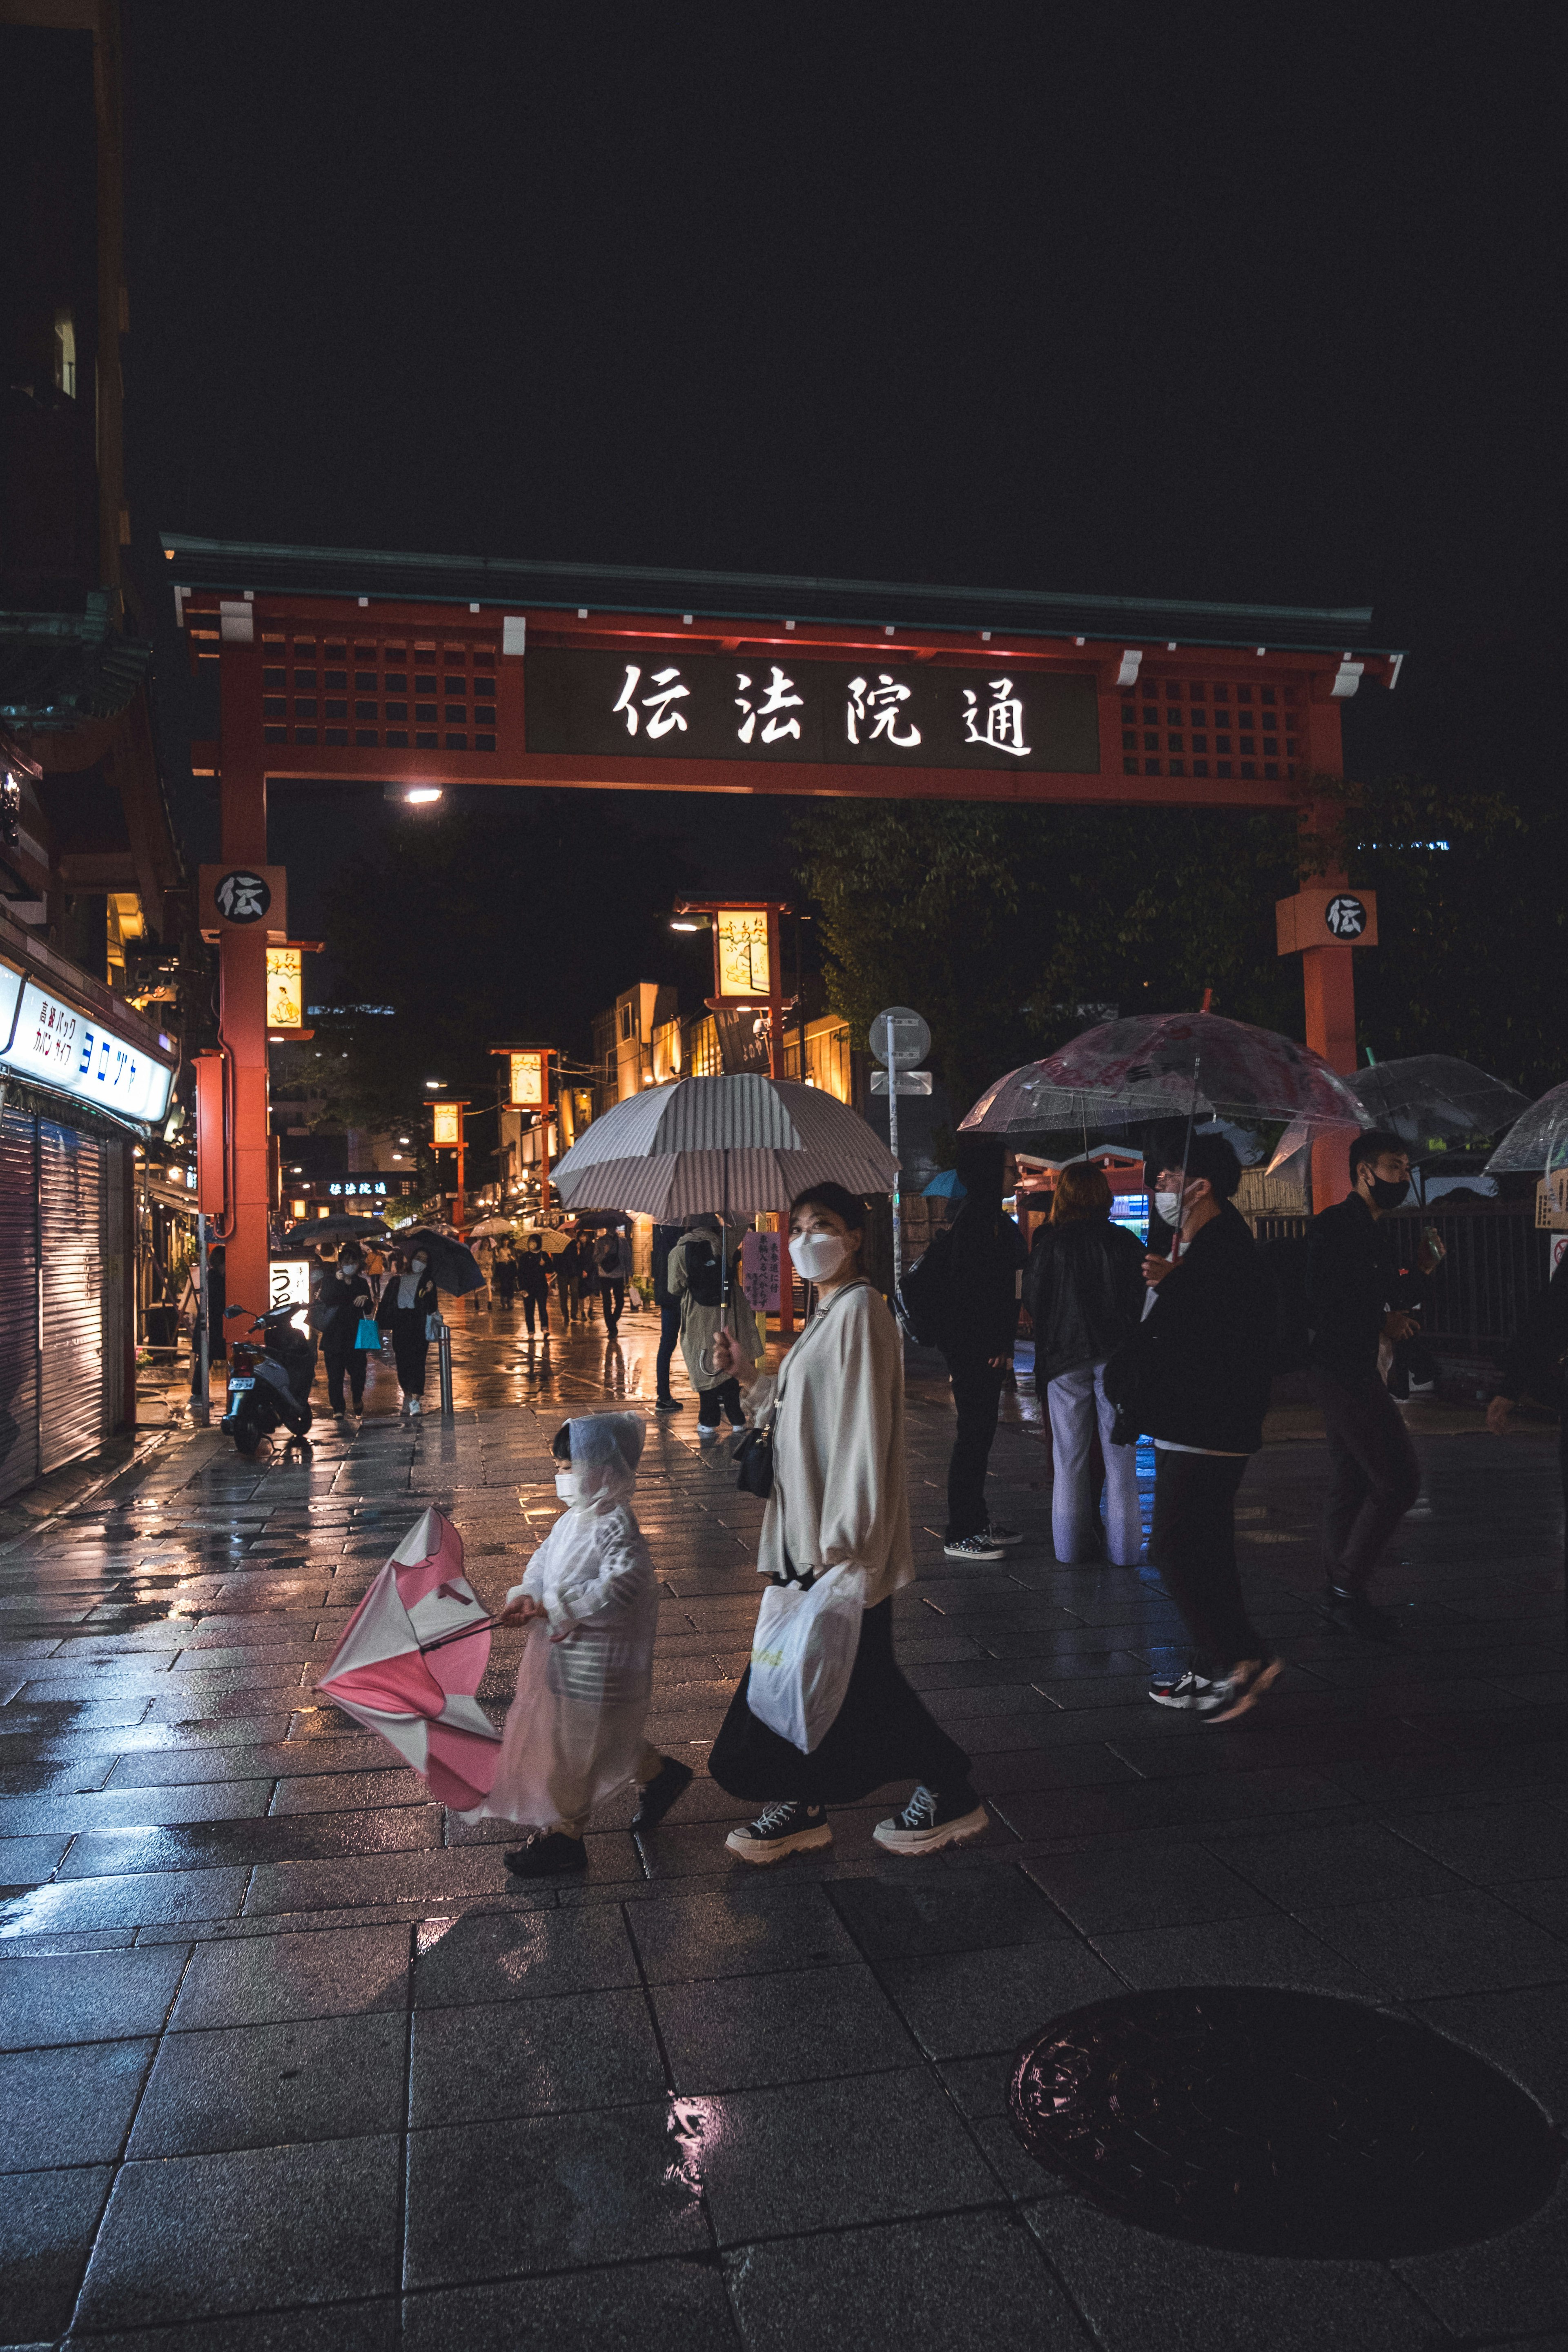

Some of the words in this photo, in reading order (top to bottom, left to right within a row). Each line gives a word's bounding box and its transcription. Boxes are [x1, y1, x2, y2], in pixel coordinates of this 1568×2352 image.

[612, 666, 1032, 756] 伝法院通
[218, 877, 263, 915] 伝
[1328, 899, 1361, 933] 伝
